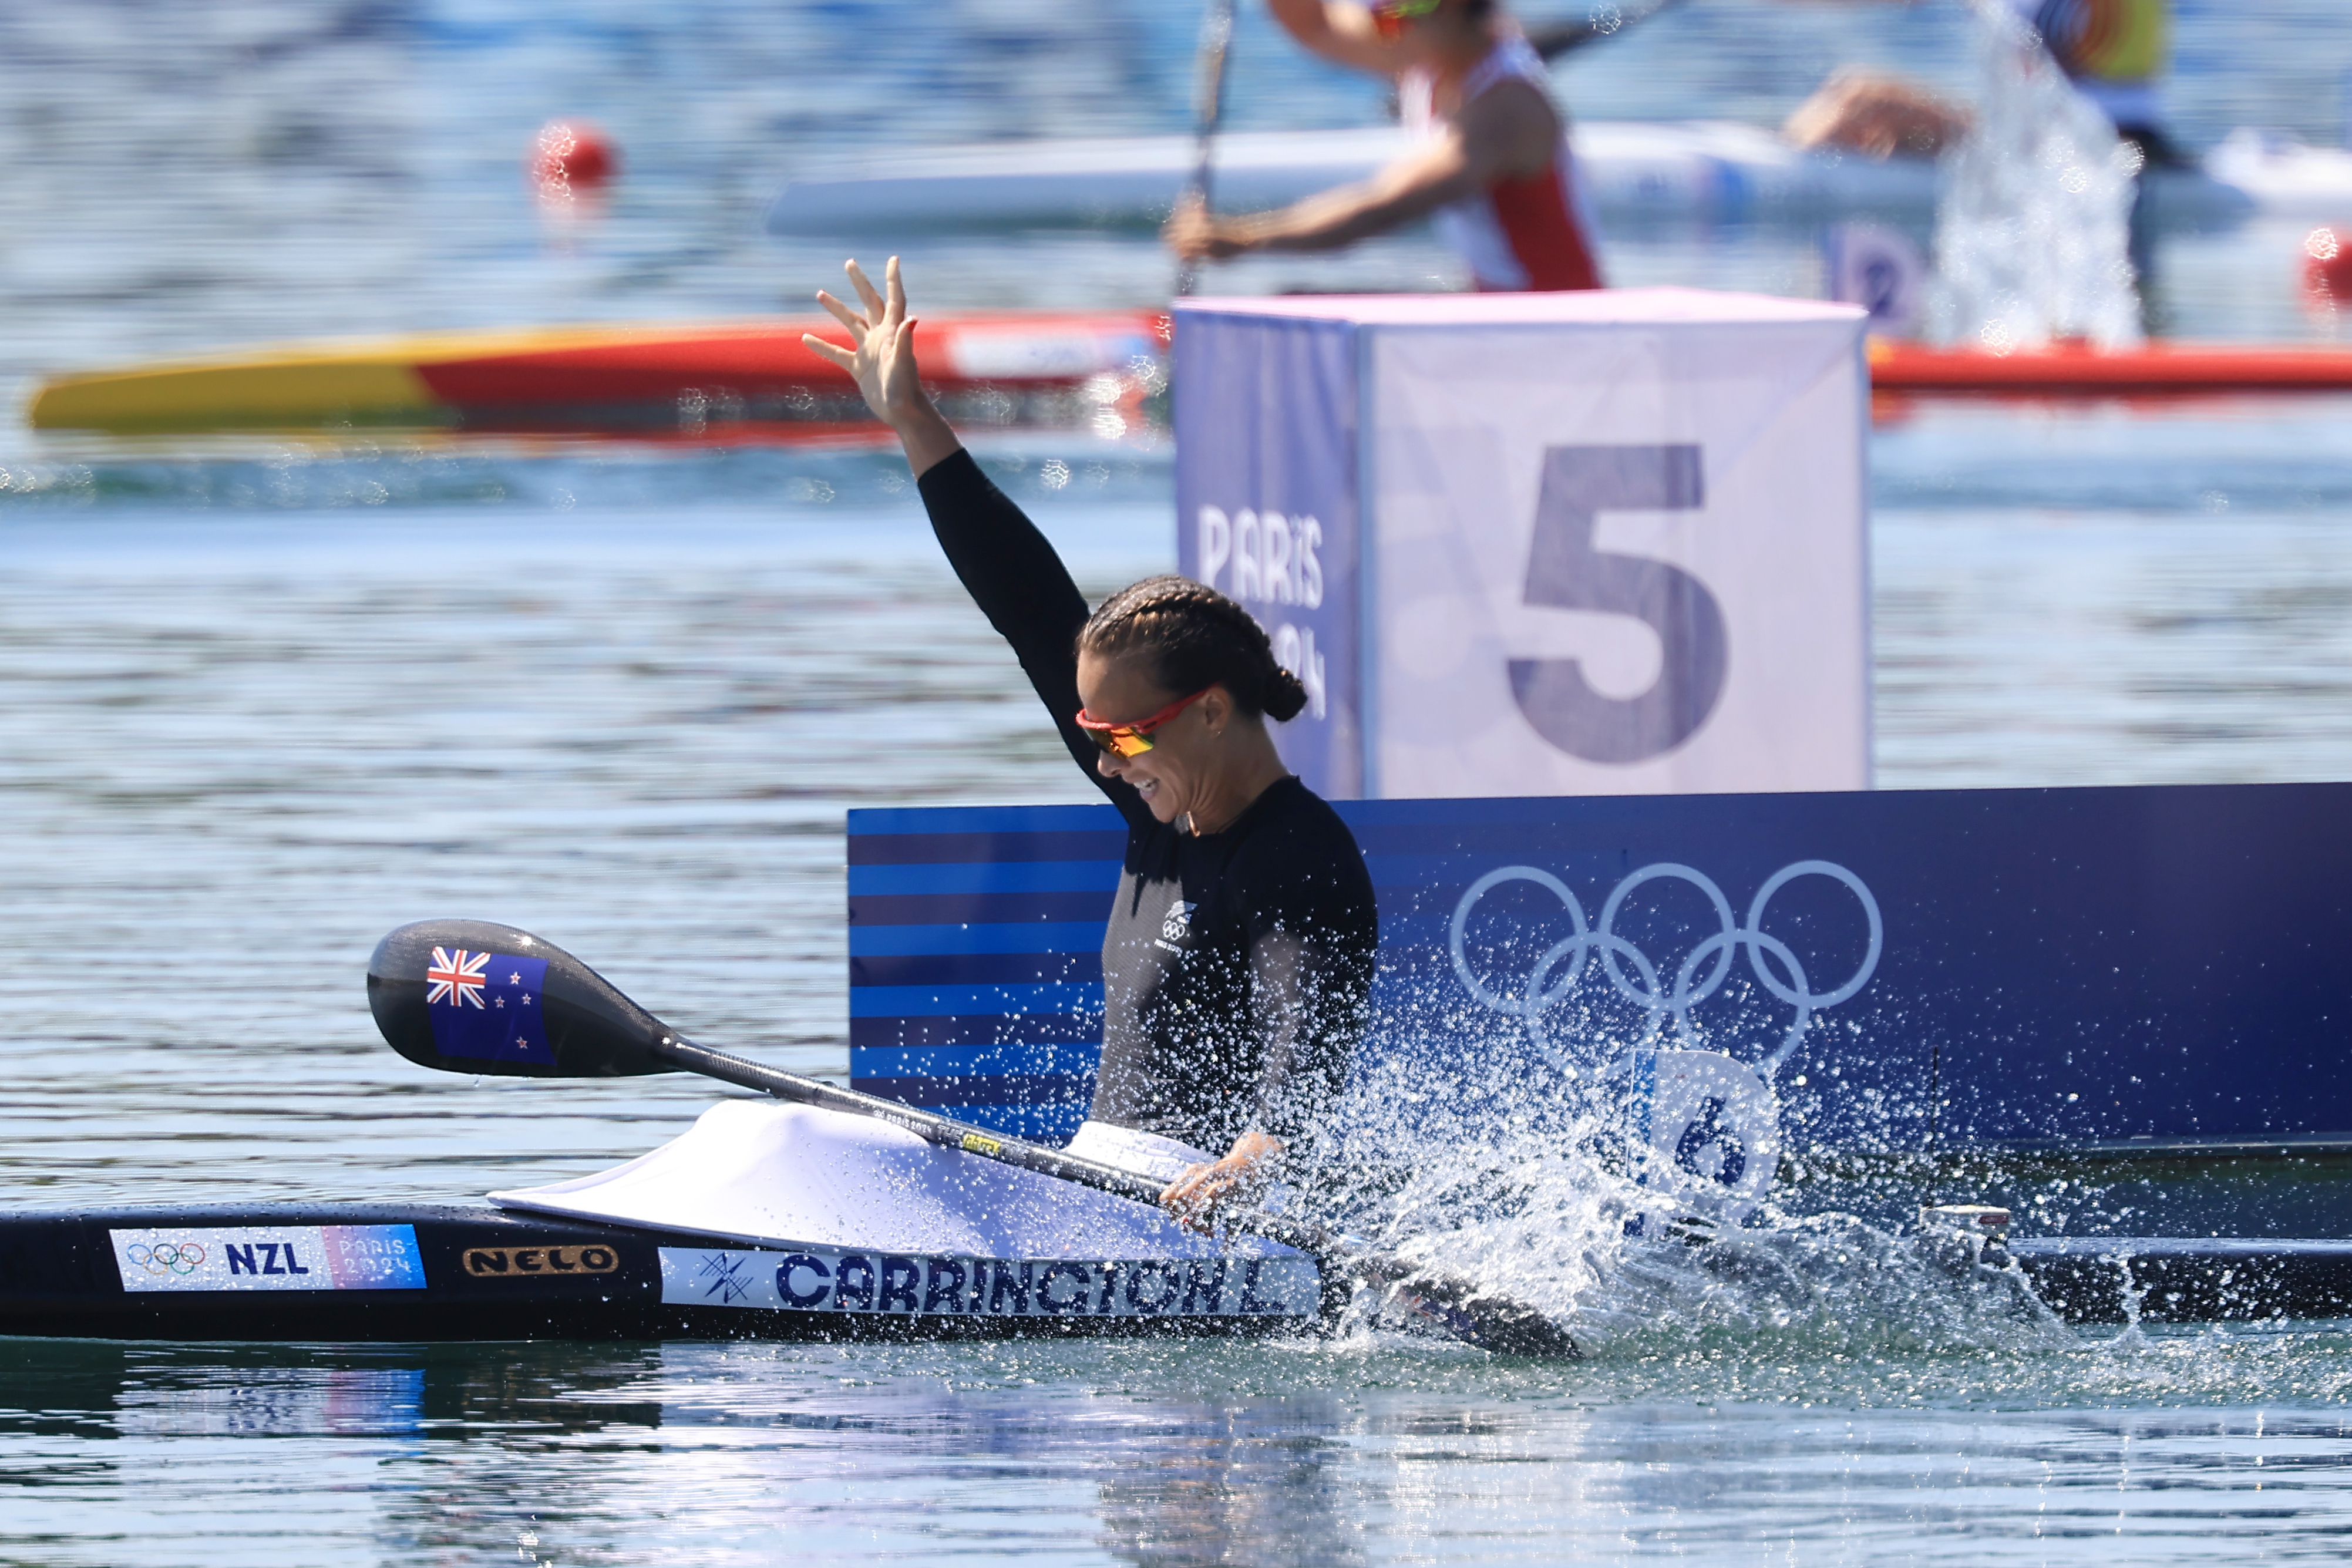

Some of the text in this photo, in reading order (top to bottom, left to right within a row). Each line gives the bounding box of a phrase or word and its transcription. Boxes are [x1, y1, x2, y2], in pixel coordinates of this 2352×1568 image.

[1506, 443, 1729, 765] 5
[1675, 1096, 1746, 1188] 6
[226, 1243, 309, 1275] NZL
[344, 1257, 411, 1274] 2024
[470, 1248, 614, 1273] NELO
[776, 1253, 1227, 1314] CARRINGTON
